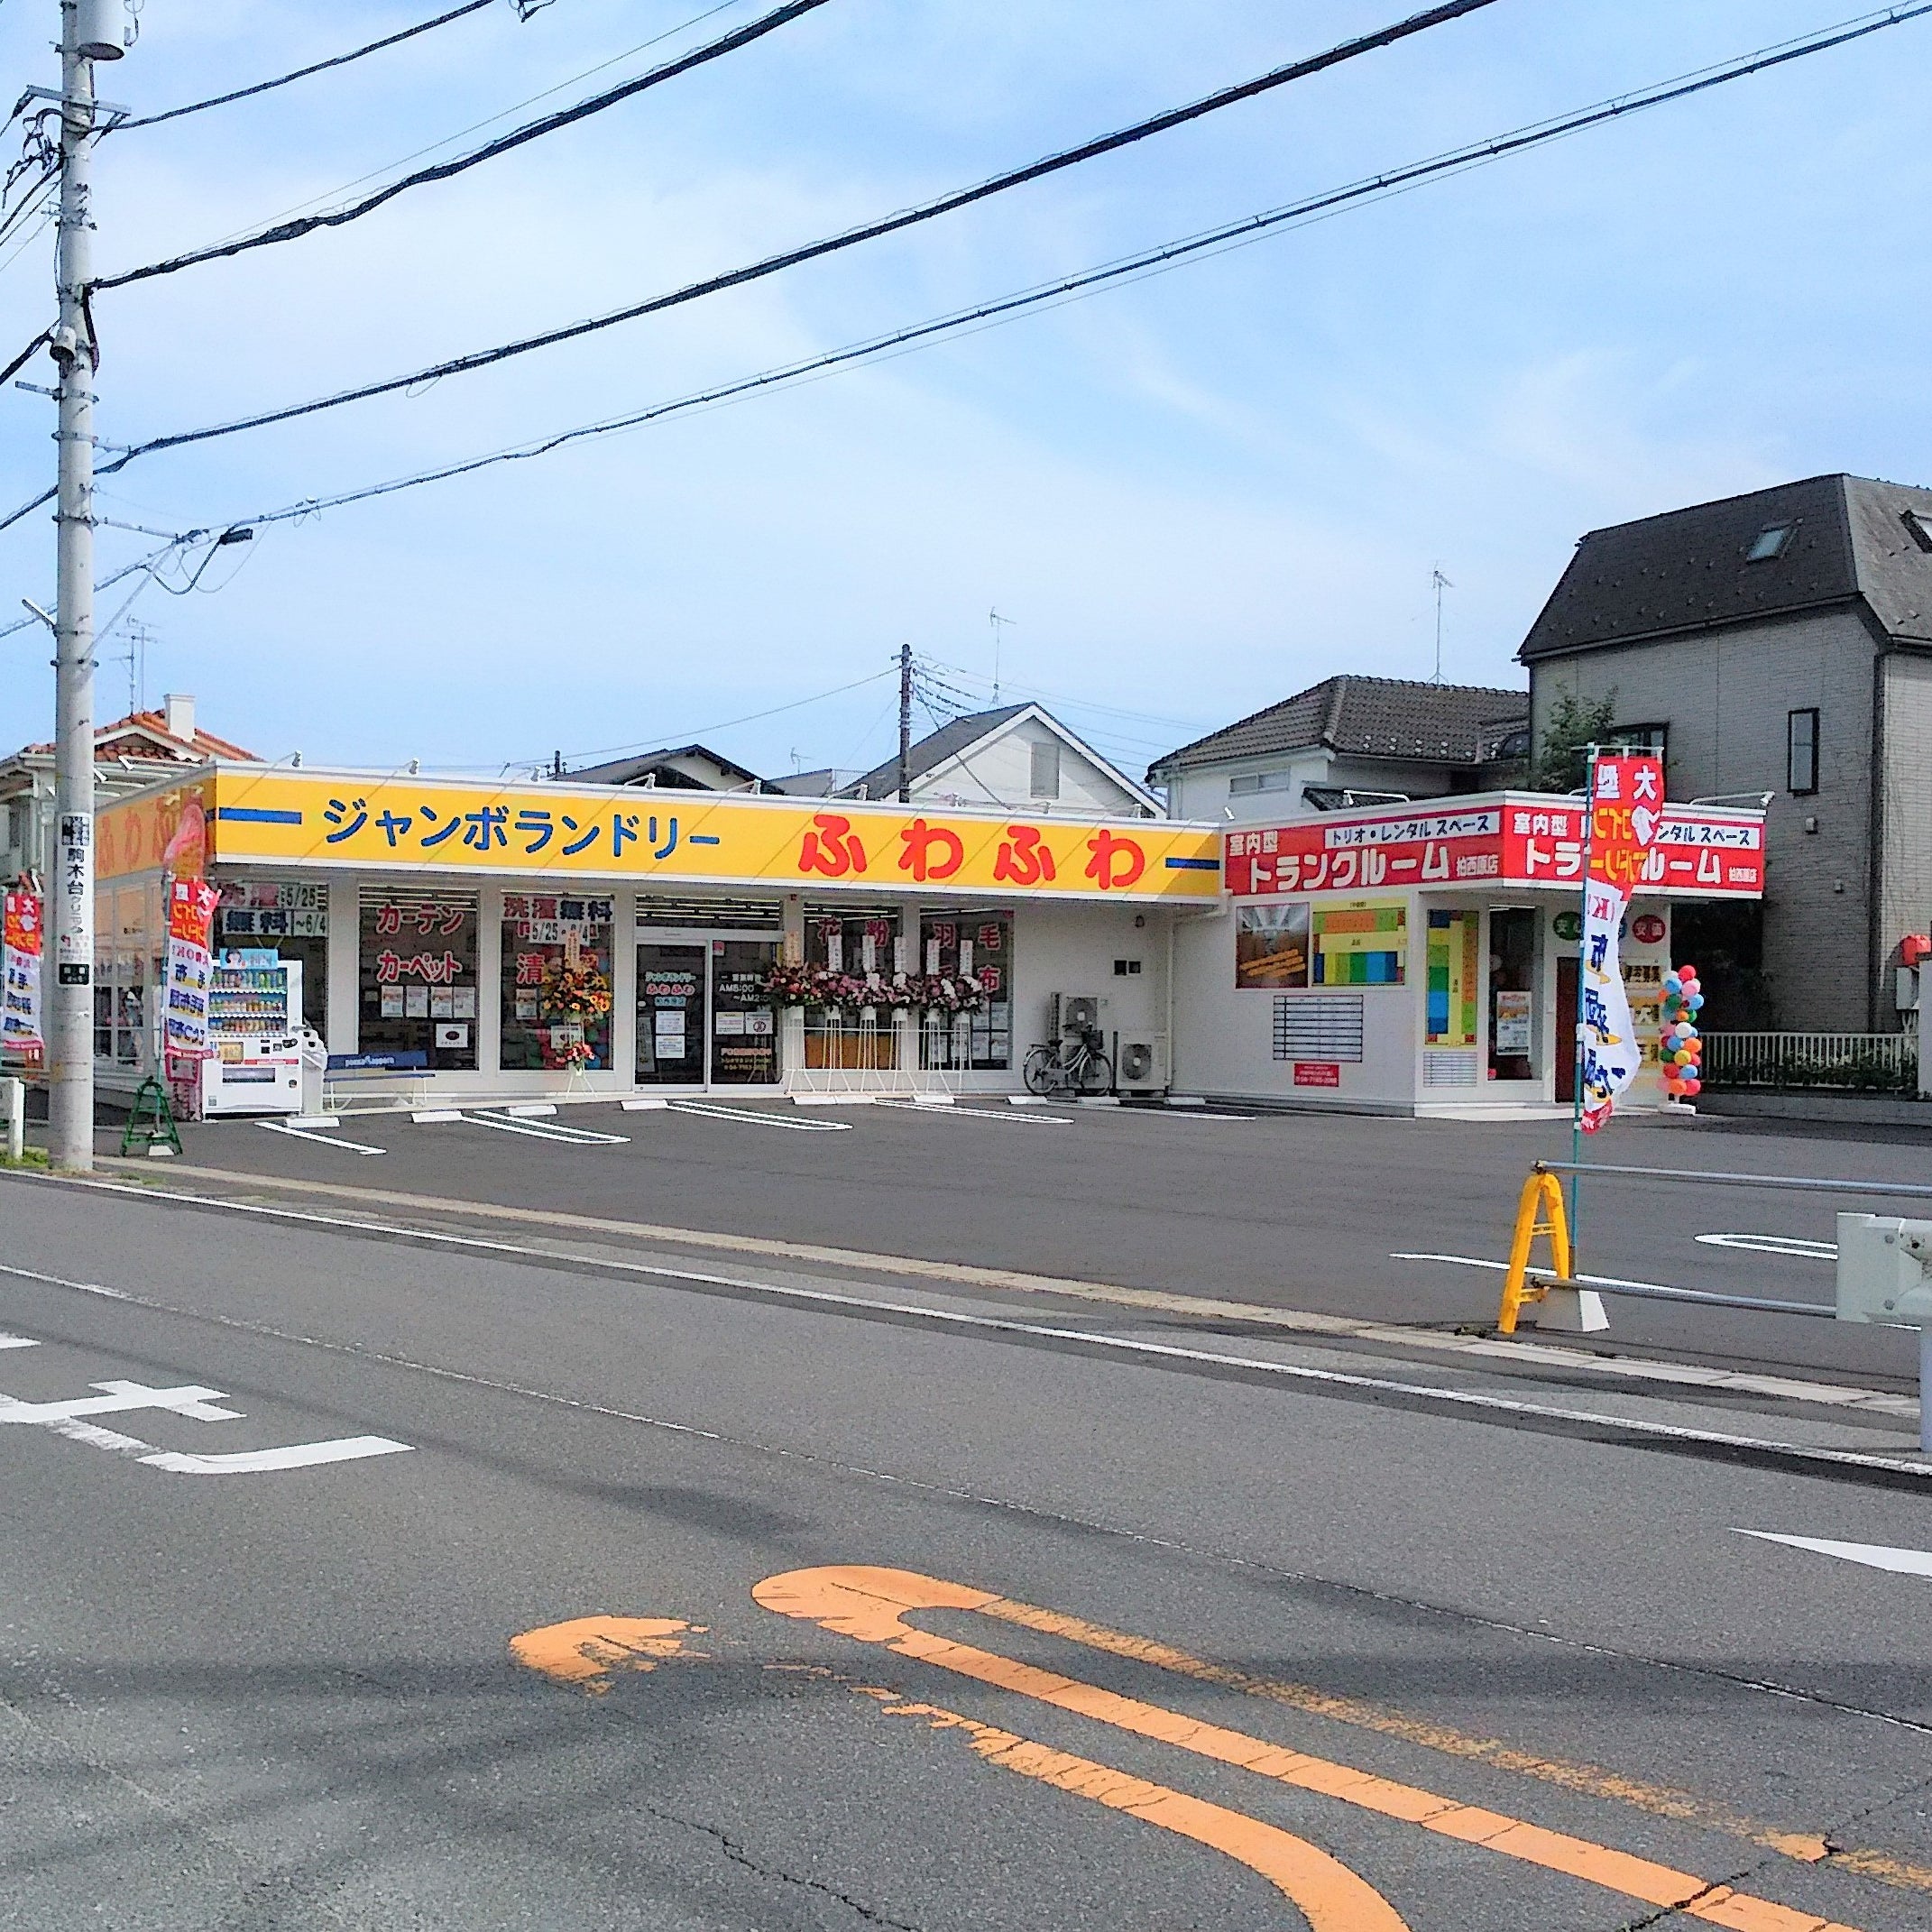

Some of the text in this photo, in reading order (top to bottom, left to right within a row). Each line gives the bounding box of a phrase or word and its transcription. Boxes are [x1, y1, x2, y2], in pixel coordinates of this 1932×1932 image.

[324, 798, 720, 860] ジャンボランドリー
[1513, 813, 1568, 837] 室内型
[798, 814, 1145, 890] ふわふわ
[1229, 831, 1278, 856] 室内型
[1251, 842, 1449, 893] トランクルーム
[376, 903, 465, 935] カーテン
[376, 949, 463, 983] カーペット
